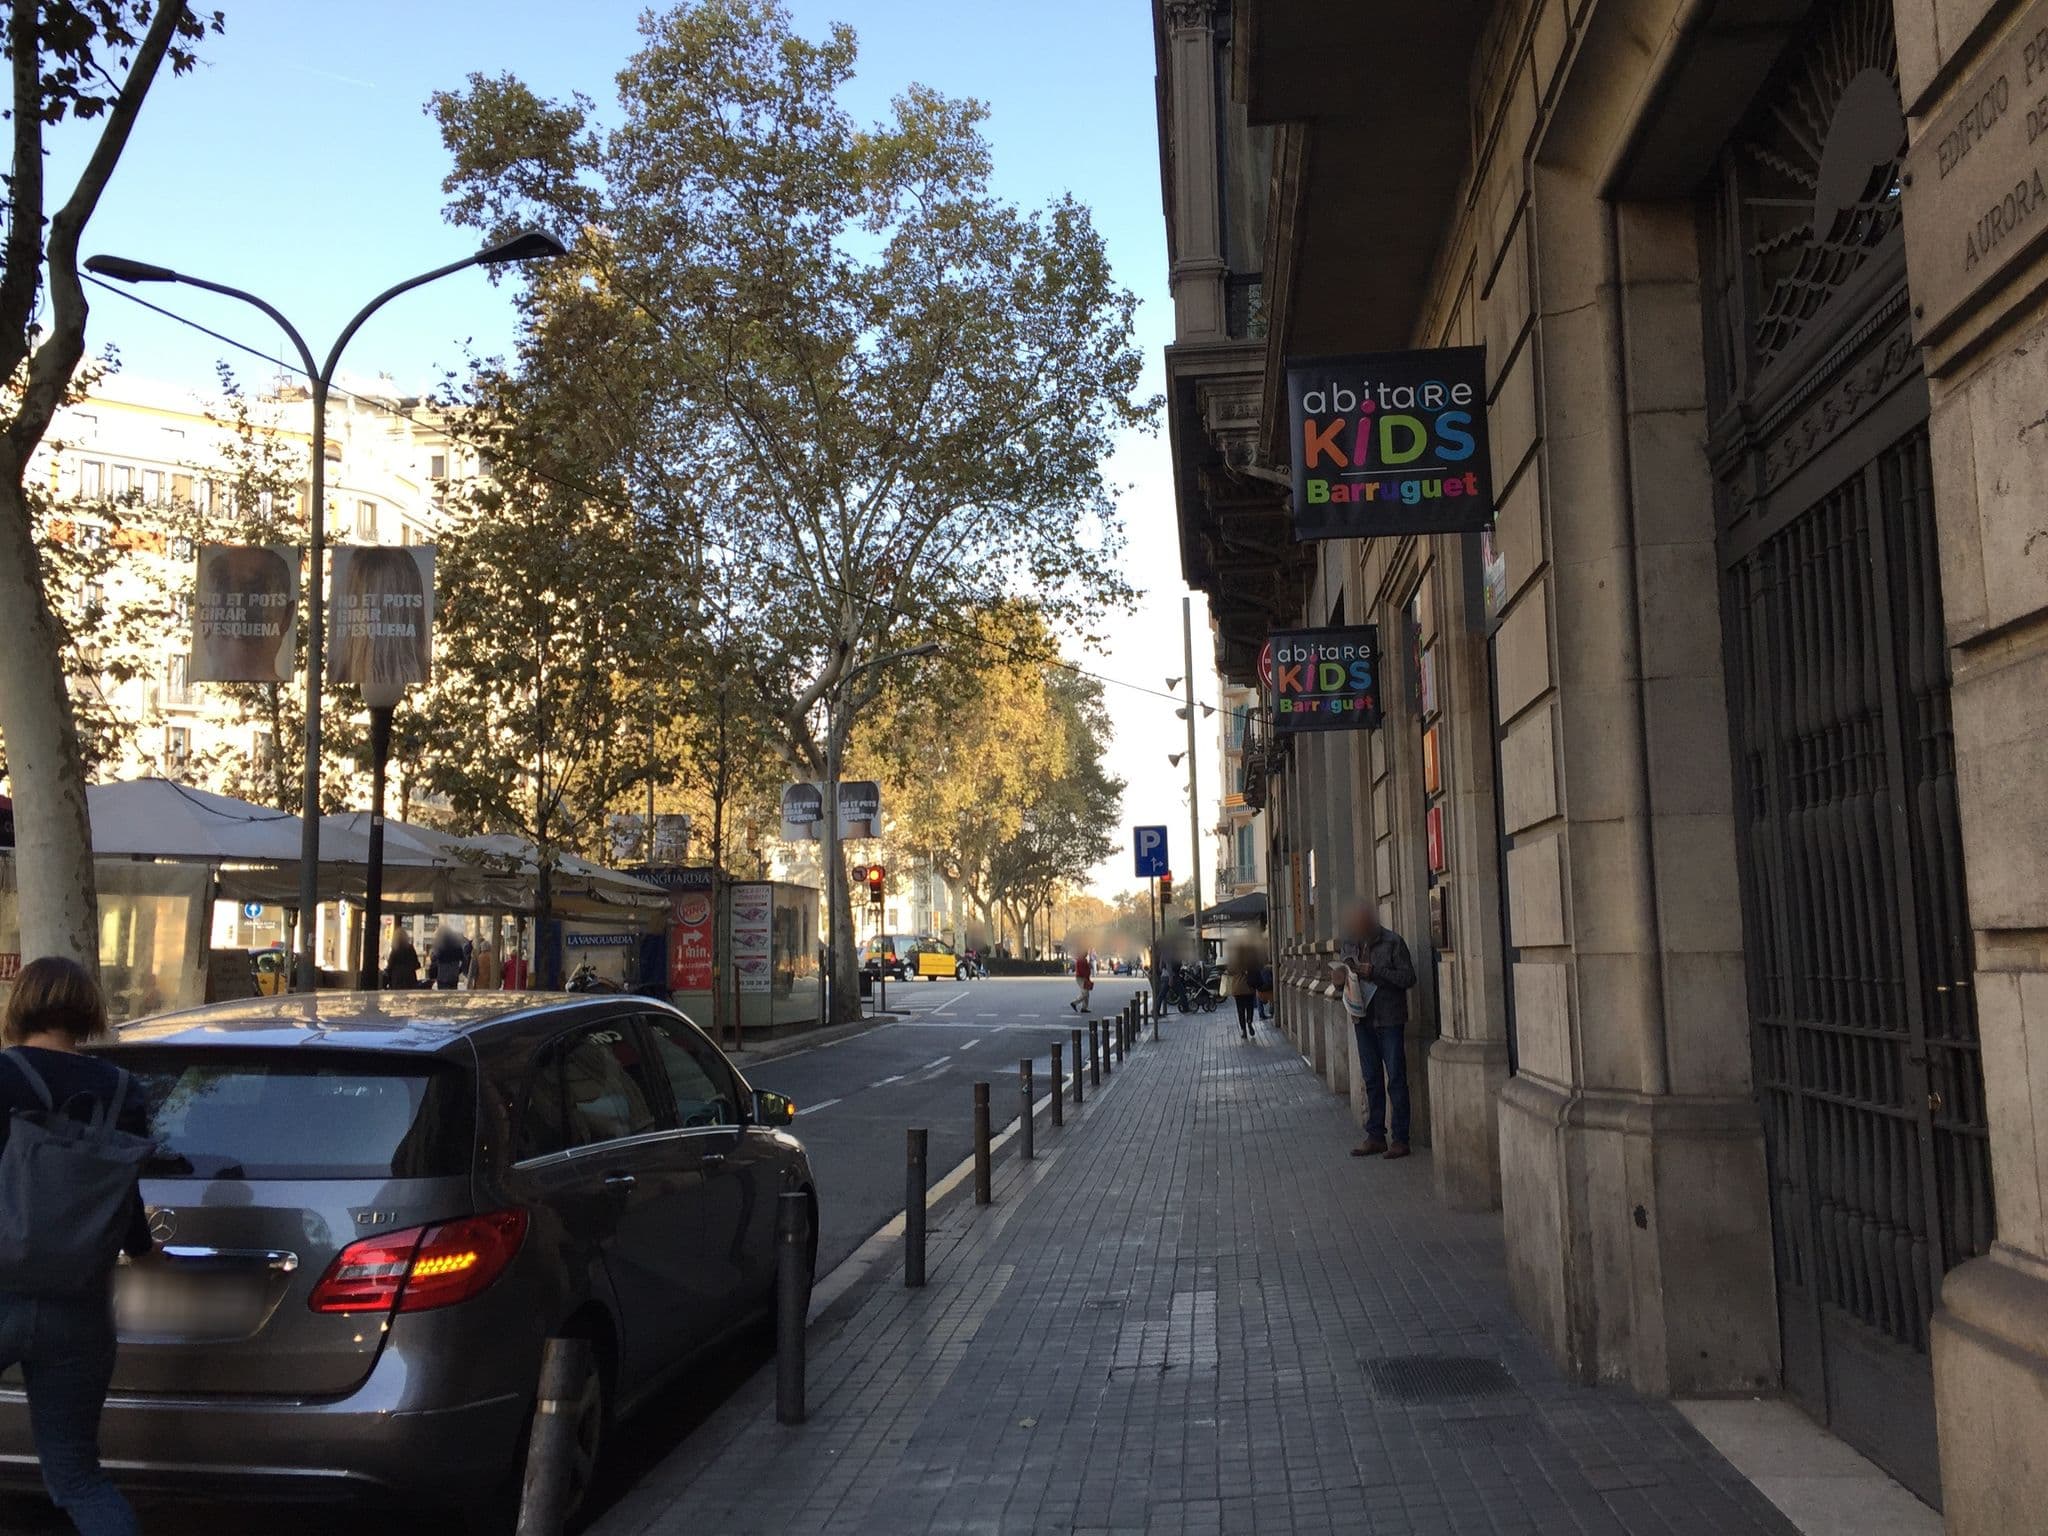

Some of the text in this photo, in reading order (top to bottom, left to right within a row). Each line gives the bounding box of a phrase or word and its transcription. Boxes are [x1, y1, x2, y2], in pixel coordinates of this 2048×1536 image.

[1938, 74, 2009, 180] EDIFICIO
[1965, 167, 2047, 271] AURORA
[1307, 472, 1479, 504] Barruguet
[200, 593, 288, 607] NO ET POTS
[338, 594, 423, 607] NO ET POTS
[200, 608, 247, 621] GIRAR
[337, 608, 381, 621] GIRAR
[201, 623, 281, 637] D'ESQUENA
[337, 624, 417, 638] D'ESQUENA
[1280, 696, 1374, 713] Barruguet
[1140, 830, 1161, 857] P
[568, 935, 634, 945] LA VANGUARDIA
[686, 945, 711, 958] min.
[357, 1211, 396, 1225] CDI
